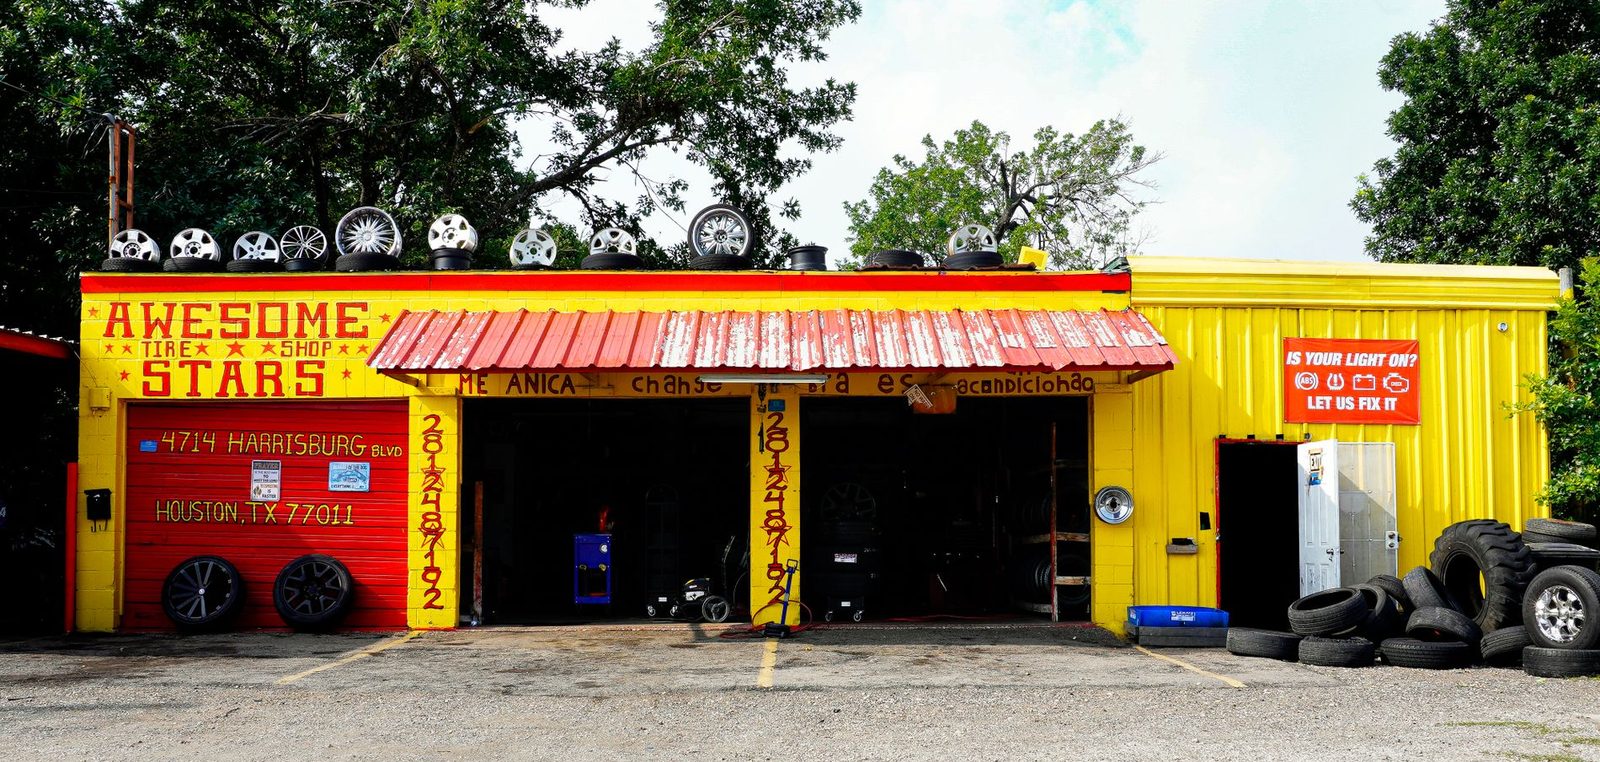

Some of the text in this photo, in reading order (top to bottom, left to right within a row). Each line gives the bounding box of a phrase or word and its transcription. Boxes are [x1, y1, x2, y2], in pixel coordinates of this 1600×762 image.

[102, 301, 369, 339] AWESOME
[141, 340, 192, 358] TIRE
[281, 340, 333, 357] SHOP
[1286, 351, 1418, 367] IS YOUR LIGHT ON?
[142, 360, 326, 397] STARS
[1300, 377, 1314, 385] ABS
[1307, 395, 1398, 411] LET US FIX IT
[161, 431, 403, 458] 4714 HARRISBURG BLVD
[285, 503, 354, 525] 77011
